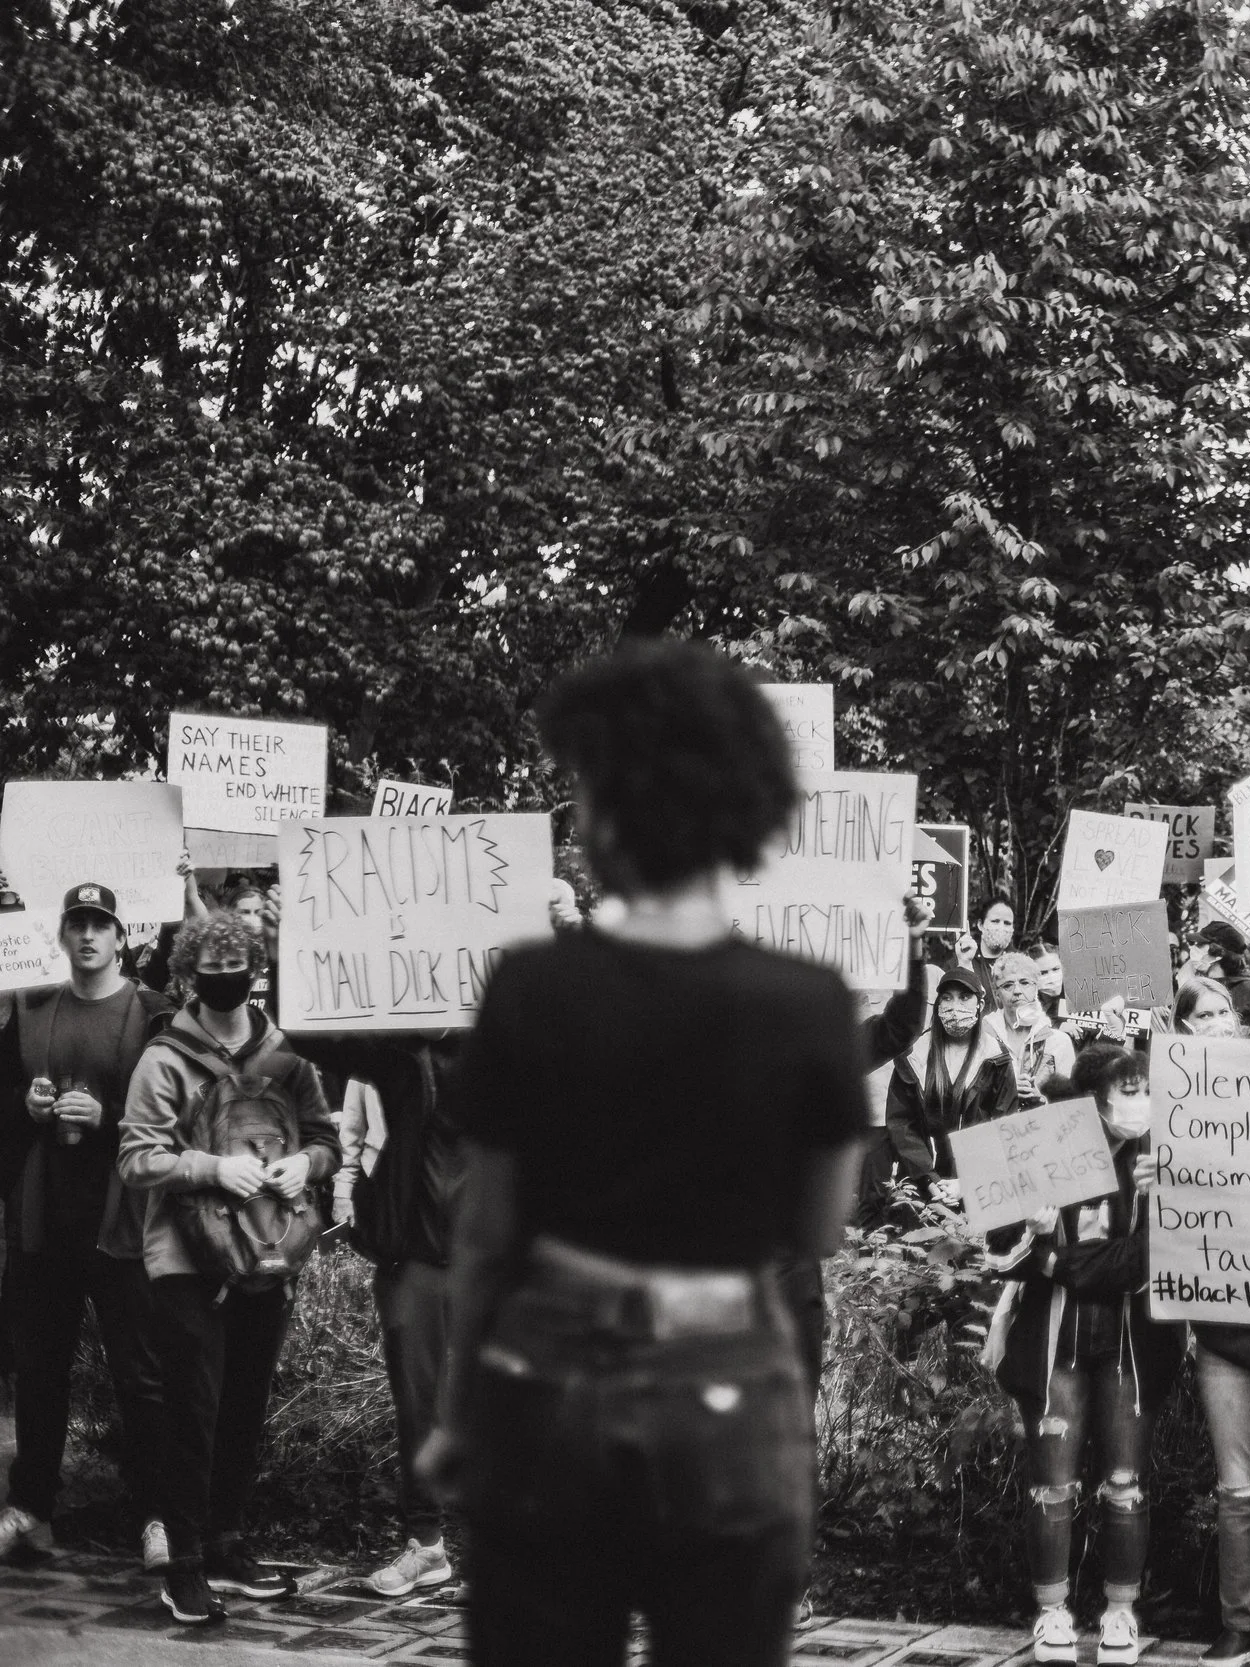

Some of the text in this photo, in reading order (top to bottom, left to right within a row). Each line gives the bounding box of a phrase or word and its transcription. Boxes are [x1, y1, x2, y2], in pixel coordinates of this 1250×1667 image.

[182, 726, 286, 755] SAY THEIR
[783, 719, 831, 742] ACK
[182, 752, 267, 778] NAMES
[226, 782, 321, 806] END WHITE
[379, 787, 450, 816] BLACK
[255, 805, 320, 822] SILENCE
[1082, 820, 1152, 849] SPREAD
[322, 824, 472, 920] RACISM
[1069, 884, 1098, 898] NOT
[390, 914, 406, 933] IS
[1066, 911, 1151, 954] BLACK
[3, 947, 18, 957] for
[751, 903, 905, 983] EVERYTHING
[0, 957, 42, 972] reonna
[1094, 955, 1127, 976] LIVES
[296, 949, 377, 1012] SMALL
[387, 949, 451, 1008] DICK
[1073, 974, 1155, 1007] MATTER
[1006, 1144, 1040, 1164] for
[1157, 1197, 1234, 1232] born
